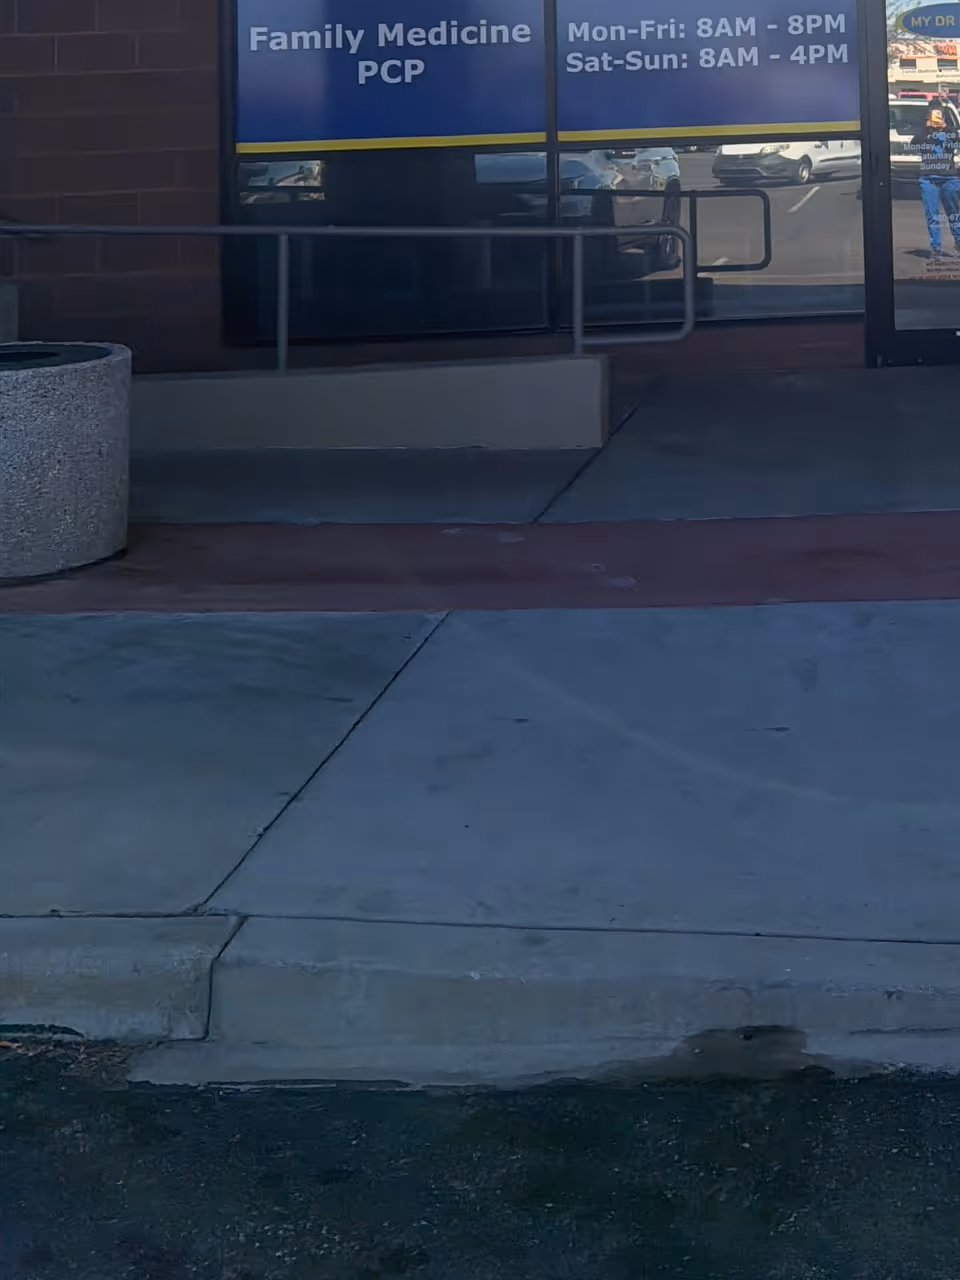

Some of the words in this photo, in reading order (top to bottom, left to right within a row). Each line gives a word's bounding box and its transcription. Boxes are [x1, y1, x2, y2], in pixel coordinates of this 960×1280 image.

[567, 18, 687, 42] Mon-Fri:
[697, 17, 756, 38] 8AM
[787, 13, 847, 35] 8PM
[911, 16, 931, 28] MY
[935, 14, 955, 26] DR
[249, 23, 365, 54] Family
[377, 19, 532, 47] Medicine
[566, 50, 689, 73] Sat-Sun:
[699, 47, 759, 68] 8AM
[790, 43, 849, 65] 4PM
[358, 59, 425, 85] PCP
[904, 142, 935, 151] Monday
[920, 162, 951, 171] Sunday
